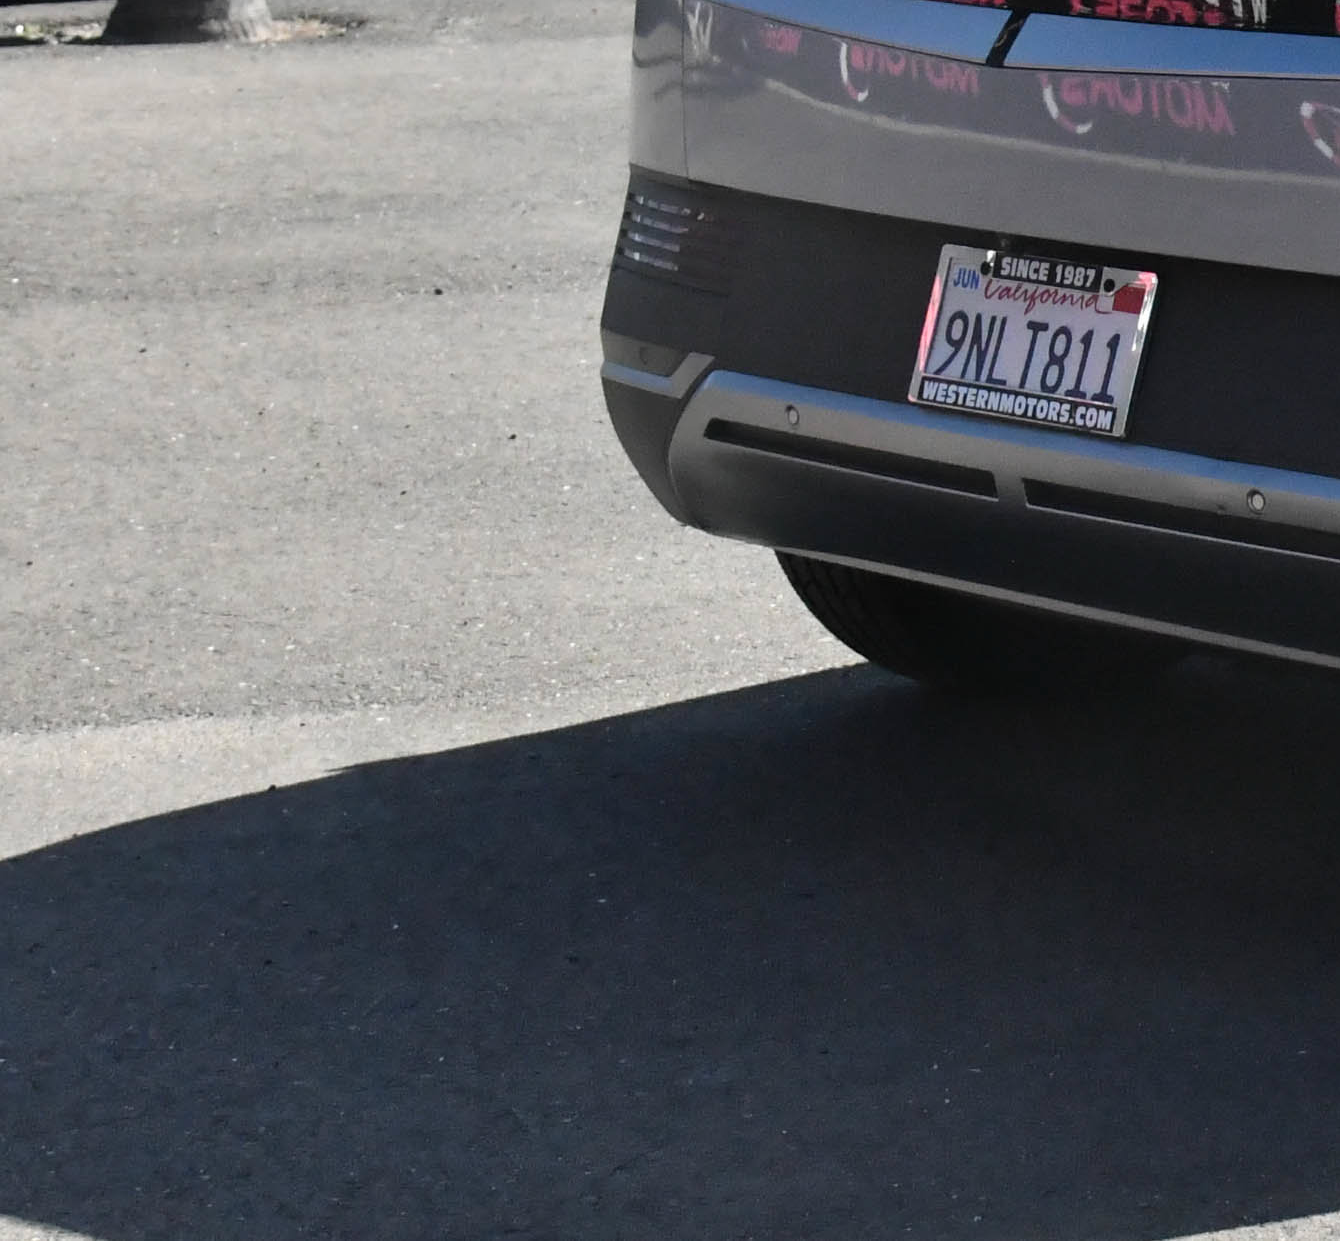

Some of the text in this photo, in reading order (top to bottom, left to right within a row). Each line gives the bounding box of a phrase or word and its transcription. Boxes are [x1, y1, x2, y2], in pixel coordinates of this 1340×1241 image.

[952, 267, 981, 290] JUN
[1000, 256, 1097, 288] SINCE 1987
[983, 278, 1112, 316] California
[933, 309, 1121, 405] 9NLT811
[921, 381, 1115, 432] WESTERNMOTORS.COM
